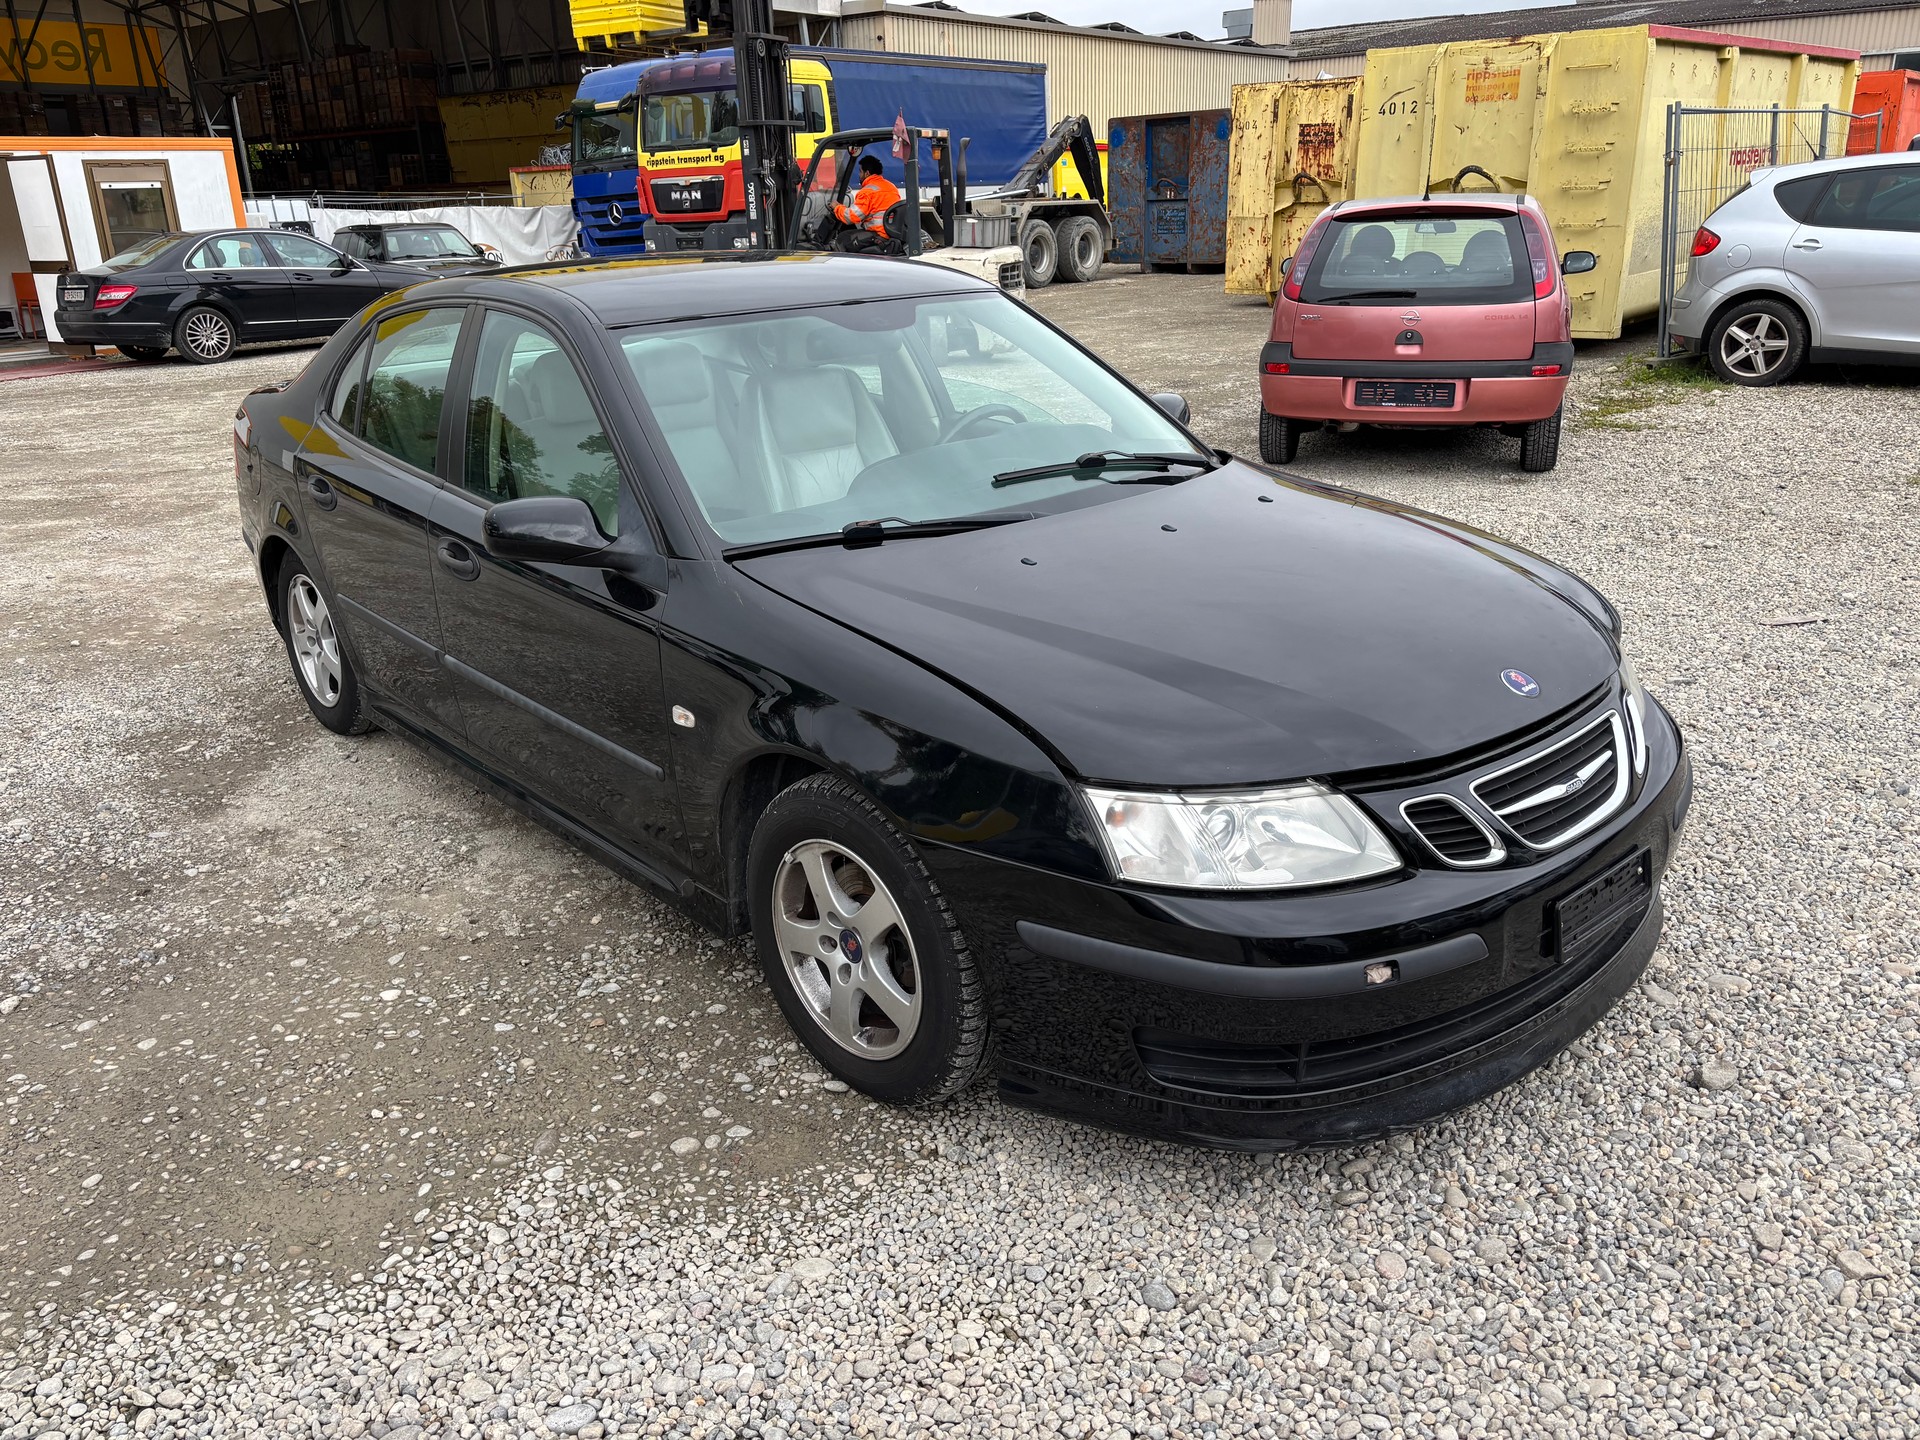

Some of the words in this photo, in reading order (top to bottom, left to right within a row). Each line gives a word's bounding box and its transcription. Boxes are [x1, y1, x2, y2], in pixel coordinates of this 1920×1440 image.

[1378, 101, 1418, 116] 4012
[646, 156, 676, 168] rippstein
[677, 154, 712, 165] transport
[713, 154, 725, 163] ag
[671, 190, 702, 200] MAN
[747, 182, 757, 213] RUBAG
